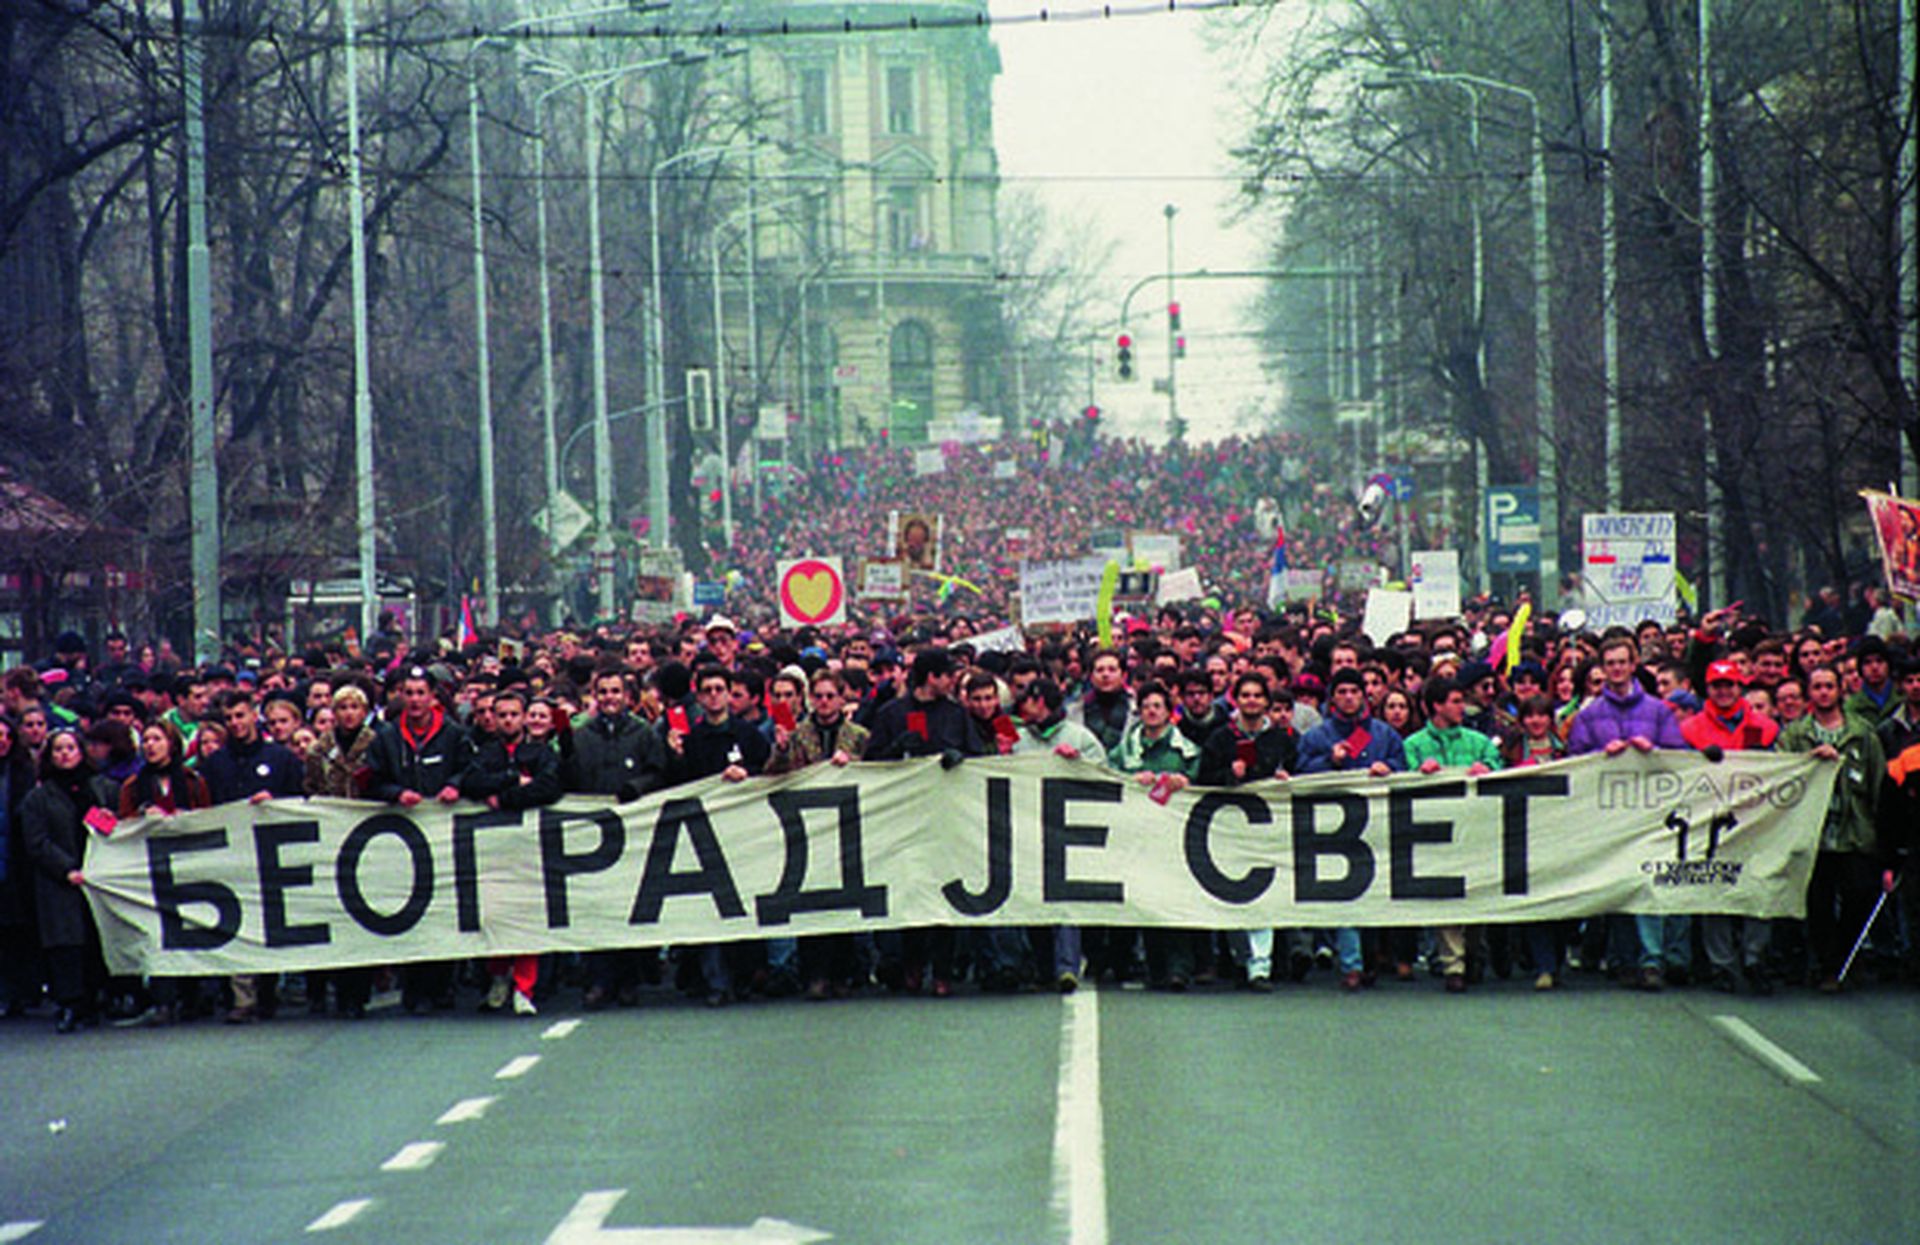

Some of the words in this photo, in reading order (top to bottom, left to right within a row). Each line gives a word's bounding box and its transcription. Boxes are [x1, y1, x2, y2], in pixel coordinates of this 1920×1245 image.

[1489, 492, 1518, 541] P
[1598, 769, 1808, 811] ПРАВО
[145, 784, 888, 951] БЕОГРАД
[941, 776, 1125, 917] ЈЕ
[1183, 774, 1570, 905] СВЕТ
